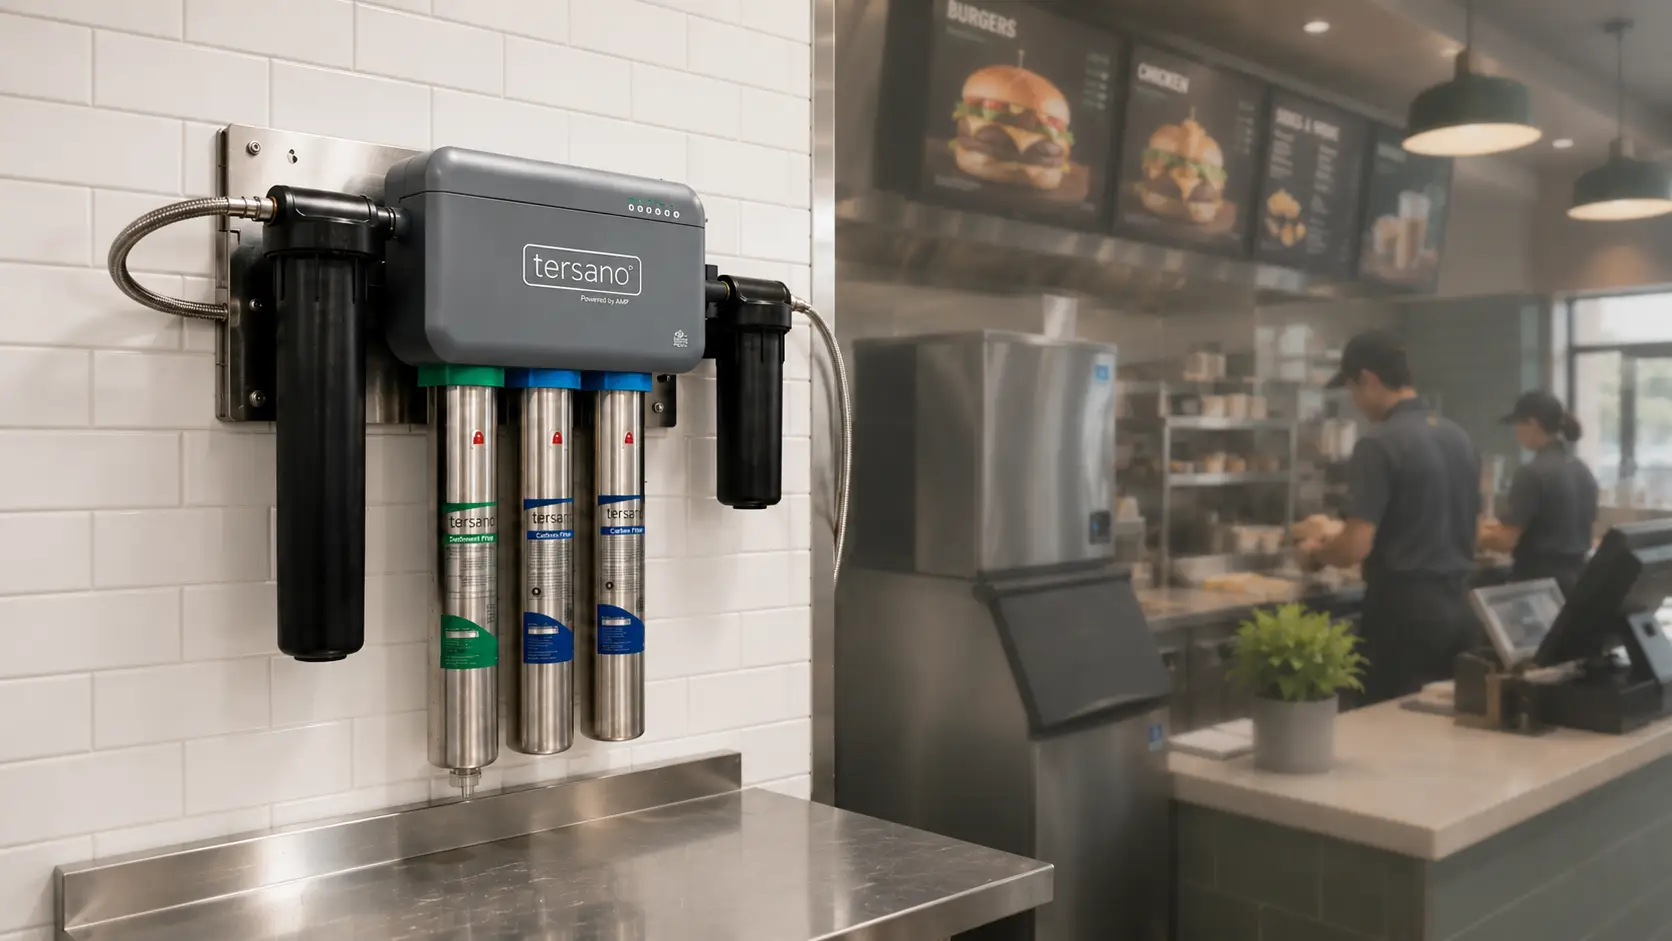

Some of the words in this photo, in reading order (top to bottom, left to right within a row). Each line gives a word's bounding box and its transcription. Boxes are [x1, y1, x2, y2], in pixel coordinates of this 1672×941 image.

[947, 0, 1017, 38] BURGERS
[1138, 62, 1190, 94] CHICKEN
[533, 253, 630, 286] tersano
[580, 294, 607, 304] Powered
[607, 297, 615, 306] by
